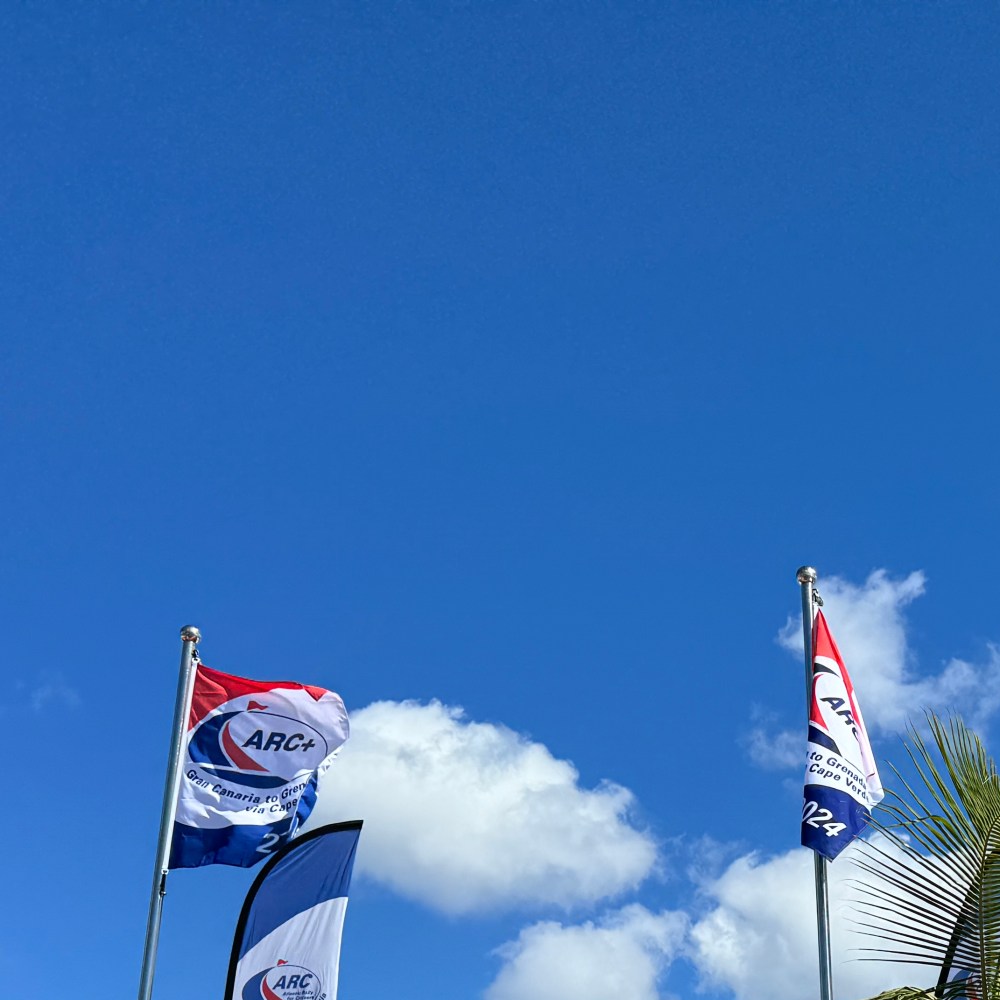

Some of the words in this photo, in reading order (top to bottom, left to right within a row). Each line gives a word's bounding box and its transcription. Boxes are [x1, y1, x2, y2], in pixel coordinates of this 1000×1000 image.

[241, 729, 316, 752] ARC+
[810, 751, 823, 762] to
[809, 763, 841, 781] Cape
[186, 769, 209, 788] Gran
[211, 784, 261, 804] Canaria
[265, 795, 278, 803] to
[281, 782, 307, 800] Gren
[801, 799, 847, 837] 024
[256, 833, 281, 854] 2
[272, 973, 313, 990] ARC
